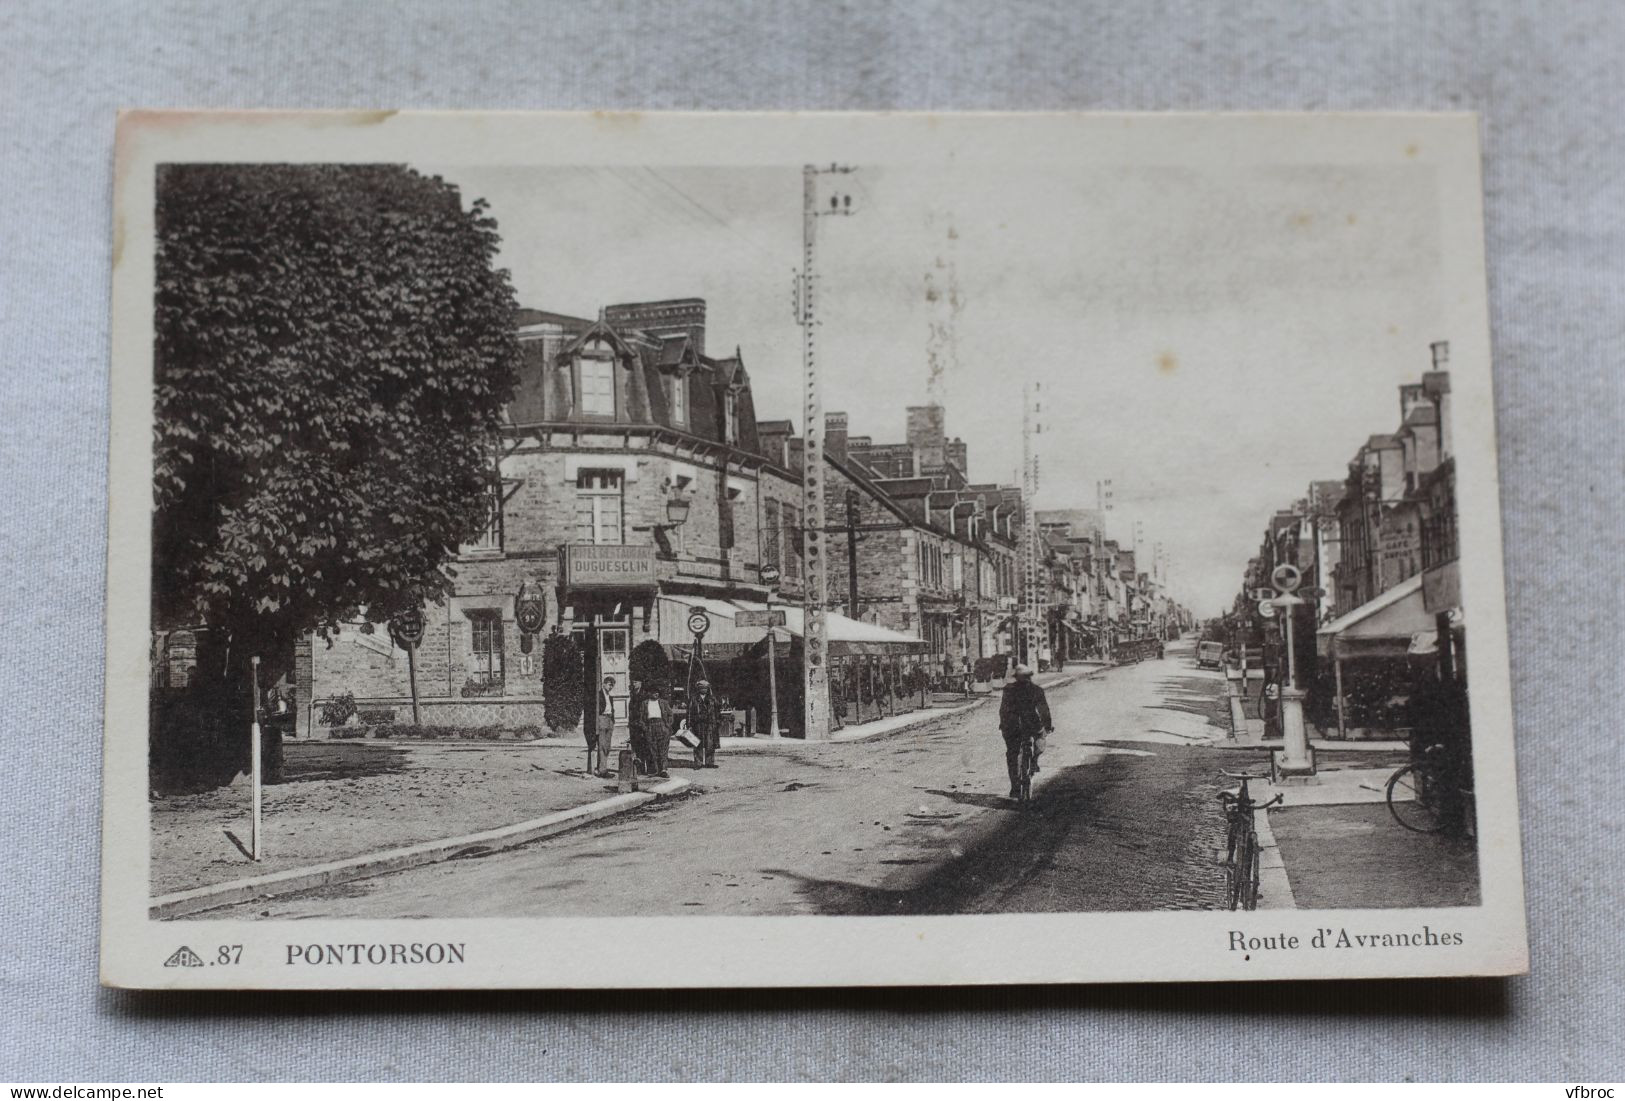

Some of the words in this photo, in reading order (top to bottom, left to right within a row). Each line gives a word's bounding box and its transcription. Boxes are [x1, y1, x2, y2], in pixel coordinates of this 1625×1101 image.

[575, 561, 648, 572] DUGUESCLIN
[1228, 930, 1299, 951] Route
[1311, 926, 1464, 949] d'Avranches
[286, 943, 465, 965] PONTORSON
